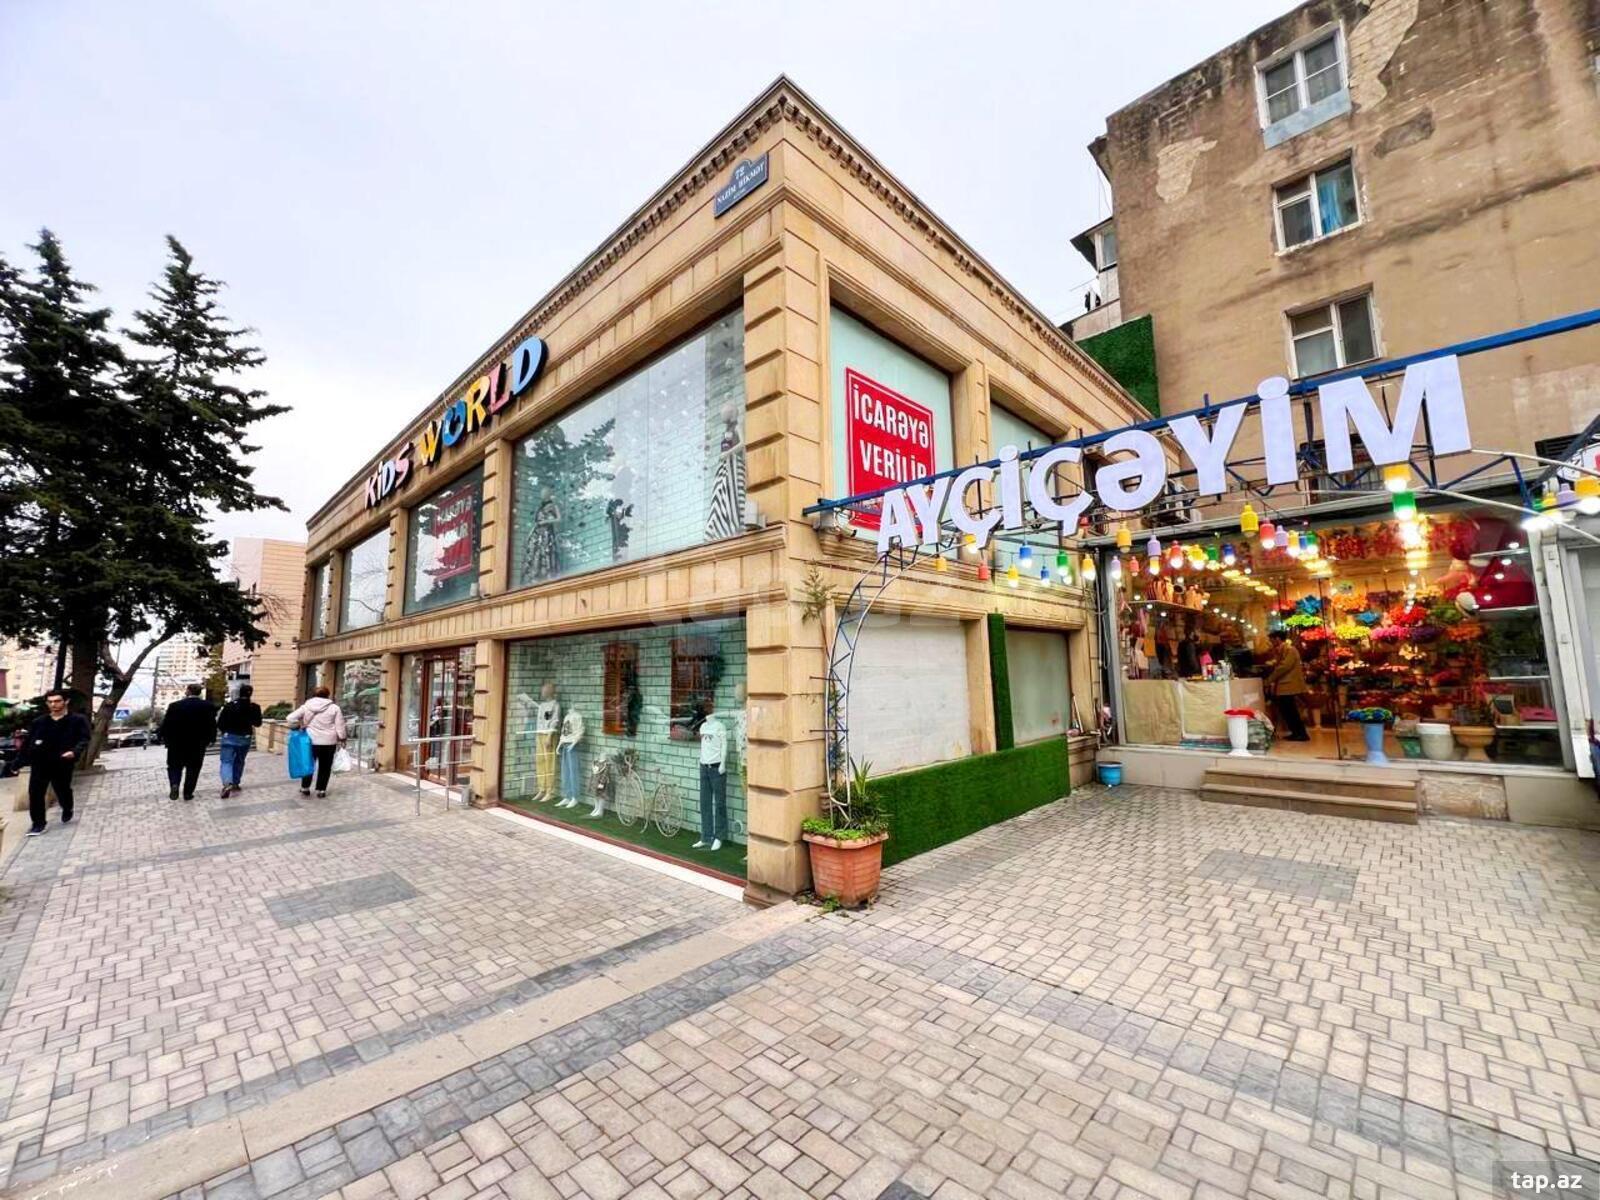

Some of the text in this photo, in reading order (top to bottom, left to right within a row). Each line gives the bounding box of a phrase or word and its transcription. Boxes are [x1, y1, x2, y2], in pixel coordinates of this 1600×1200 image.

[418, 335, 546, 466] WORLD
[853, 383, 930, 450] İCARƏYƏ
[876, 353, 1473, 557] AYÇİÇƏYİM
